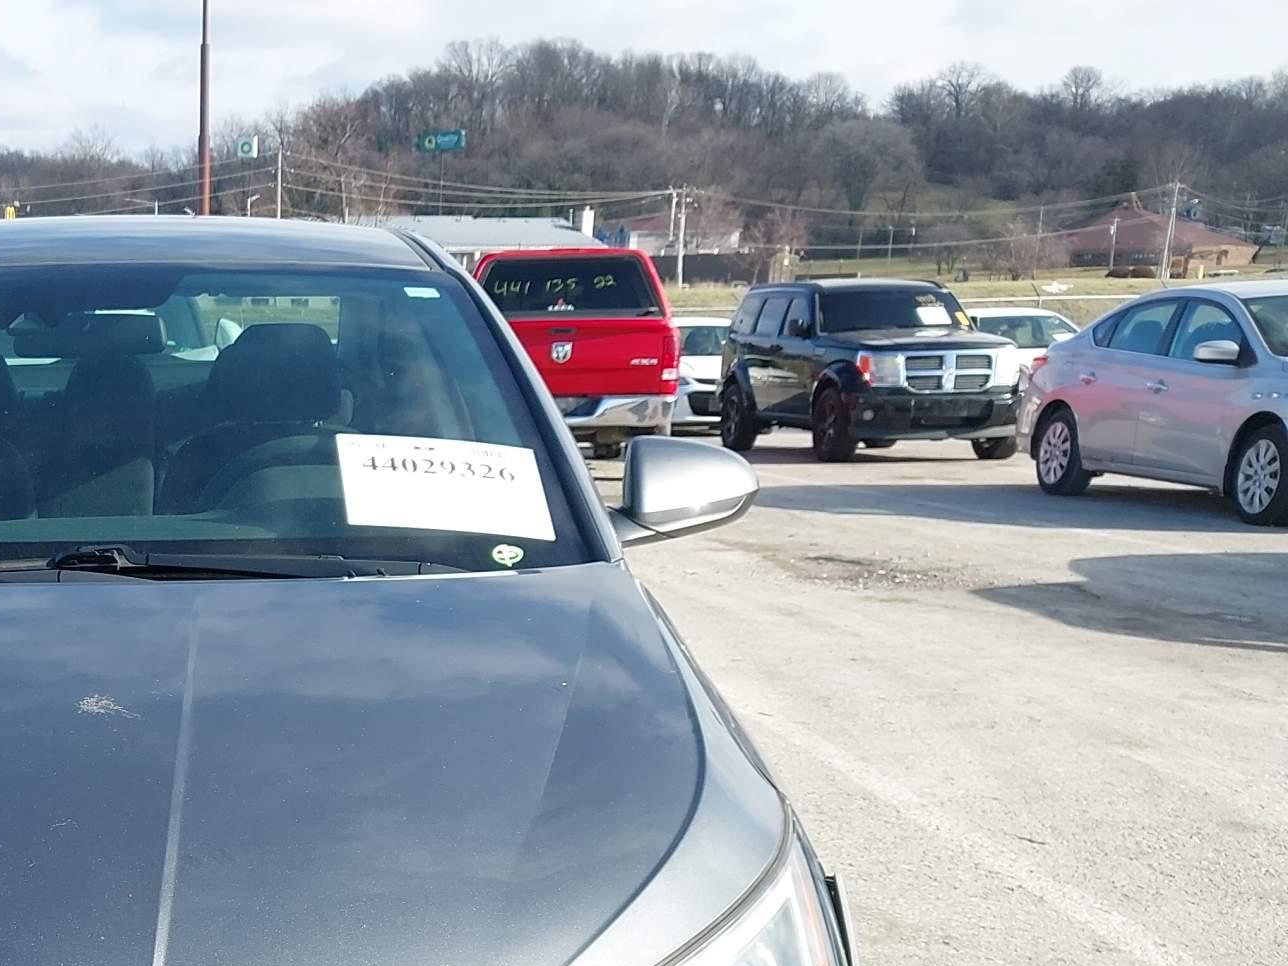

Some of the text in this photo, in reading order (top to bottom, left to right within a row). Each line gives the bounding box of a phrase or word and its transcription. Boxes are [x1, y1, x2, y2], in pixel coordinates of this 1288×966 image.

[493, 279, 531, 296] 441
[593, 275, 616, 289] 22
[362, 456, 515, 482] 44029326
